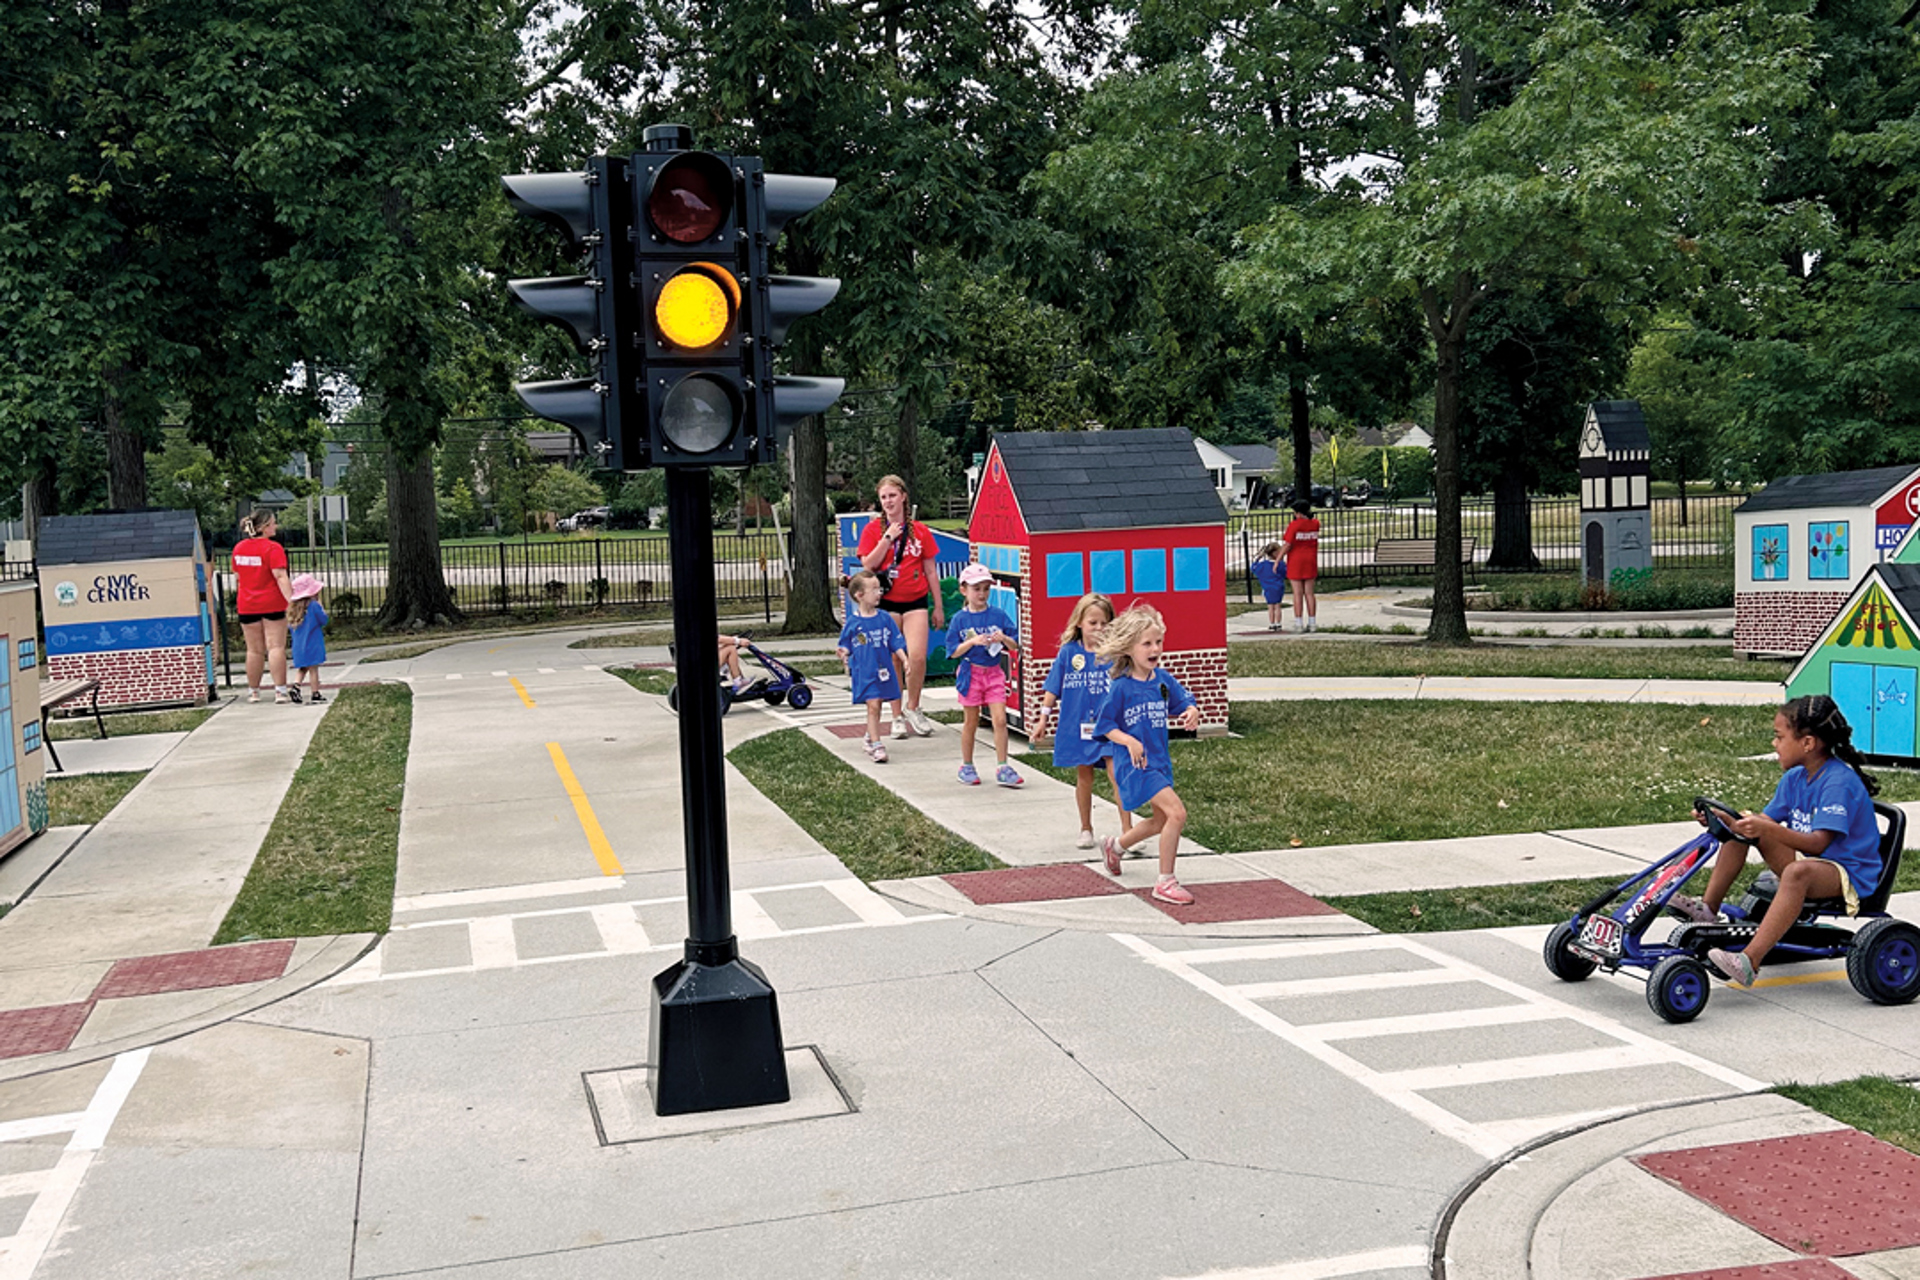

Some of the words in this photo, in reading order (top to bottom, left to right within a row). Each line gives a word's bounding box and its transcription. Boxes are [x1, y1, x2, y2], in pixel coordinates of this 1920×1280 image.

[94, 574, 138, 588] CIVIC
[87, 586, 150, 603] CENTER
[1861, 603, 1890, 615] PET
[1854, 616, 1898, 631] SHOP
[1594, 920, 1613, 941] 01
